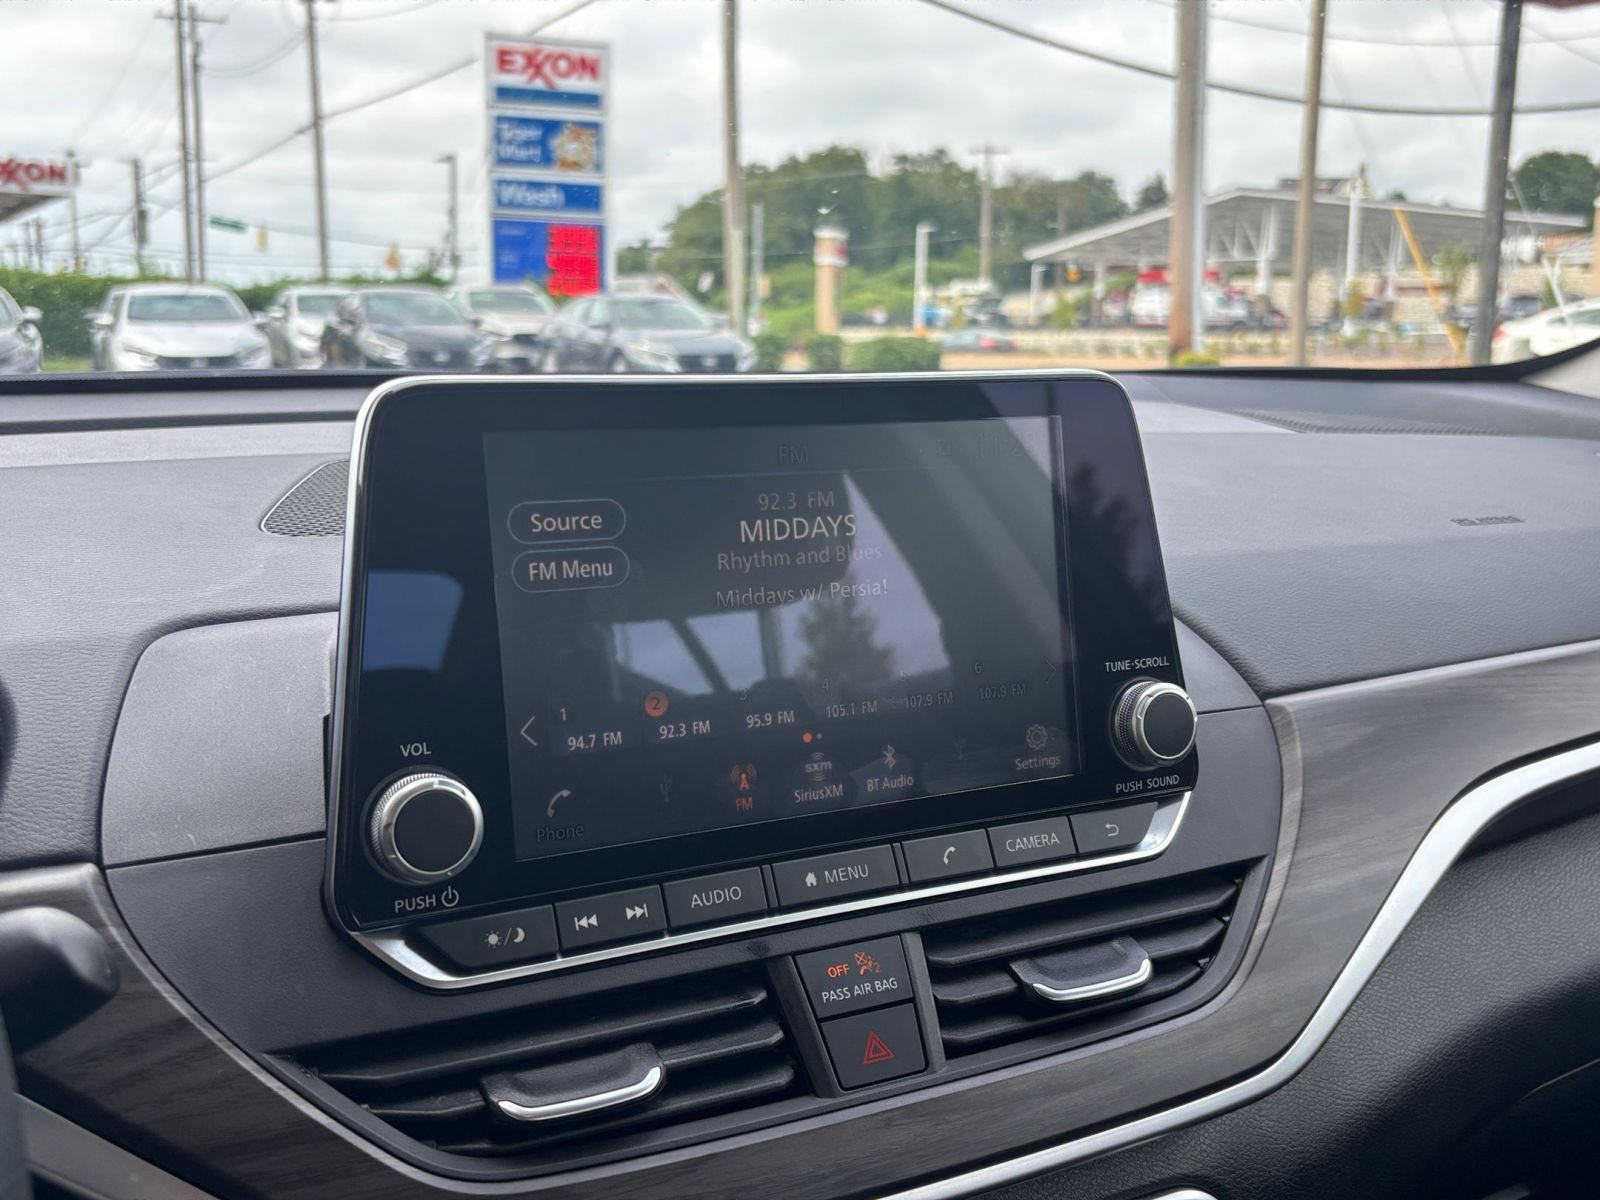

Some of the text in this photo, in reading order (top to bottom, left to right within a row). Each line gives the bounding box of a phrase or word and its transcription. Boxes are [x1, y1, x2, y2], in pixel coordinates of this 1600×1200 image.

[496, 46, 600, 88] EXXON
[778, 446, 809, 465] FM
[758, 490, 835, 511] 92.3 FM
[530, 512, 603, 533] Source
[739, 514, 857, 543] MIDDAYS
[717, 543, 882, 574] Rhythm and Blues
[529, 559, 614, 581] FM Menu
[716, 578, 888, 608] Middays w/ Persia!
[903, 691, 954, 709] 107.9 FM
[978, 683, 1027, 700] 107.9 FM
[560, 707, 568, 721] 1
[826, 699, 878, 719] 105.1 FM
[659, 719, 711, 739] 92.3 FM
[745, 710, 795, 729] 95.9 FM
[400, 742, 432, 757] VOL
[567, 731, 622, 751] 94.7 FM
[1014, 753, 1061, 771] Settings
[866, 773, 914, 792] BT Audio
[1115, 774, 1180, 794] PUSH SOUND
[794, 783, 844, 803] SiriusXM
[735, 796, 753, 812] FM
[536, 823, 585, 843] Phone
[1005, 832, 1061, 852] CAMERA
[824, 863, 869, 884] MENU
[394, 894, 437, 913] PUSH
[691, 886, 742, 908] AUDIO
[827, 963, 850, 978] OFF
[821, 977, 898, 1003] PASS AIR BAG
